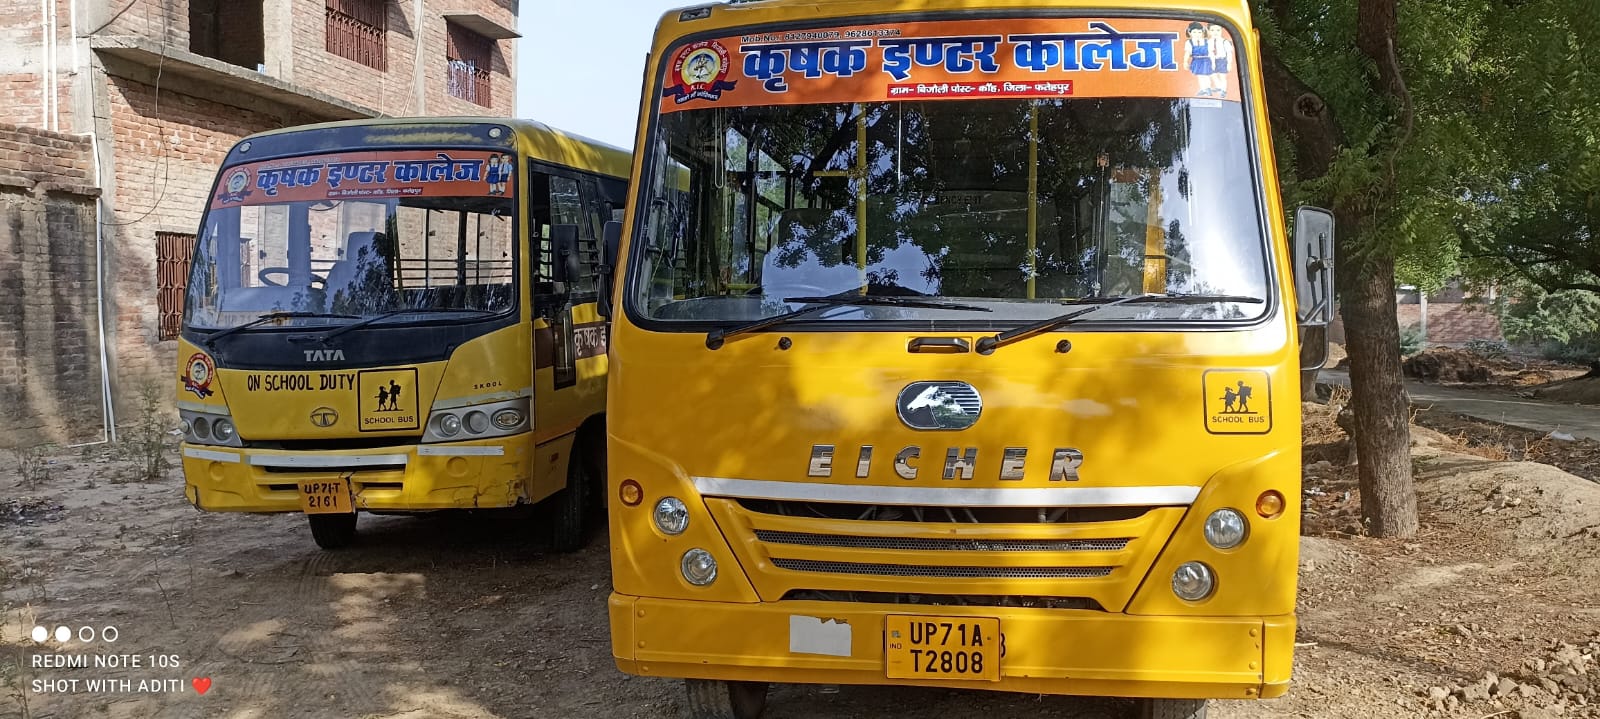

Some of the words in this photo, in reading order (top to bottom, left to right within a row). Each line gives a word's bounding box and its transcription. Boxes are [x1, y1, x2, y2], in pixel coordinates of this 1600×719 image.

[738, 39, 873, 93] कृषक
[878, 35, 1002, 81] इण्टर
[1008, 22, 1180, 73] कालेज
[1034, 82, 1070, 94] फतेहपुर
[256, 162, 325, 196] कृषक
[327, 160, 391, 189] इण्टर
[393, 152, 486, 183] कालेज
[573, 327, 599, 356] कृषक
[304, 349, 346, 362] TATA
[247, 374, 261, 392] ON
[265, 374, 314, 391] SCHOOL
[319, 373, 356, 391] DUTY
[473, 381, 502, 390] SKOOL
[364, 416, 395, 425] SCHOOL
[397, 415, 414, 423] BUS
[807, 444, 1084, 481] EICHER
[308, 495, 338, 508] 2161
[910, 622, 983, 646] UP71A
[910, 649, 983, 673] T2808
